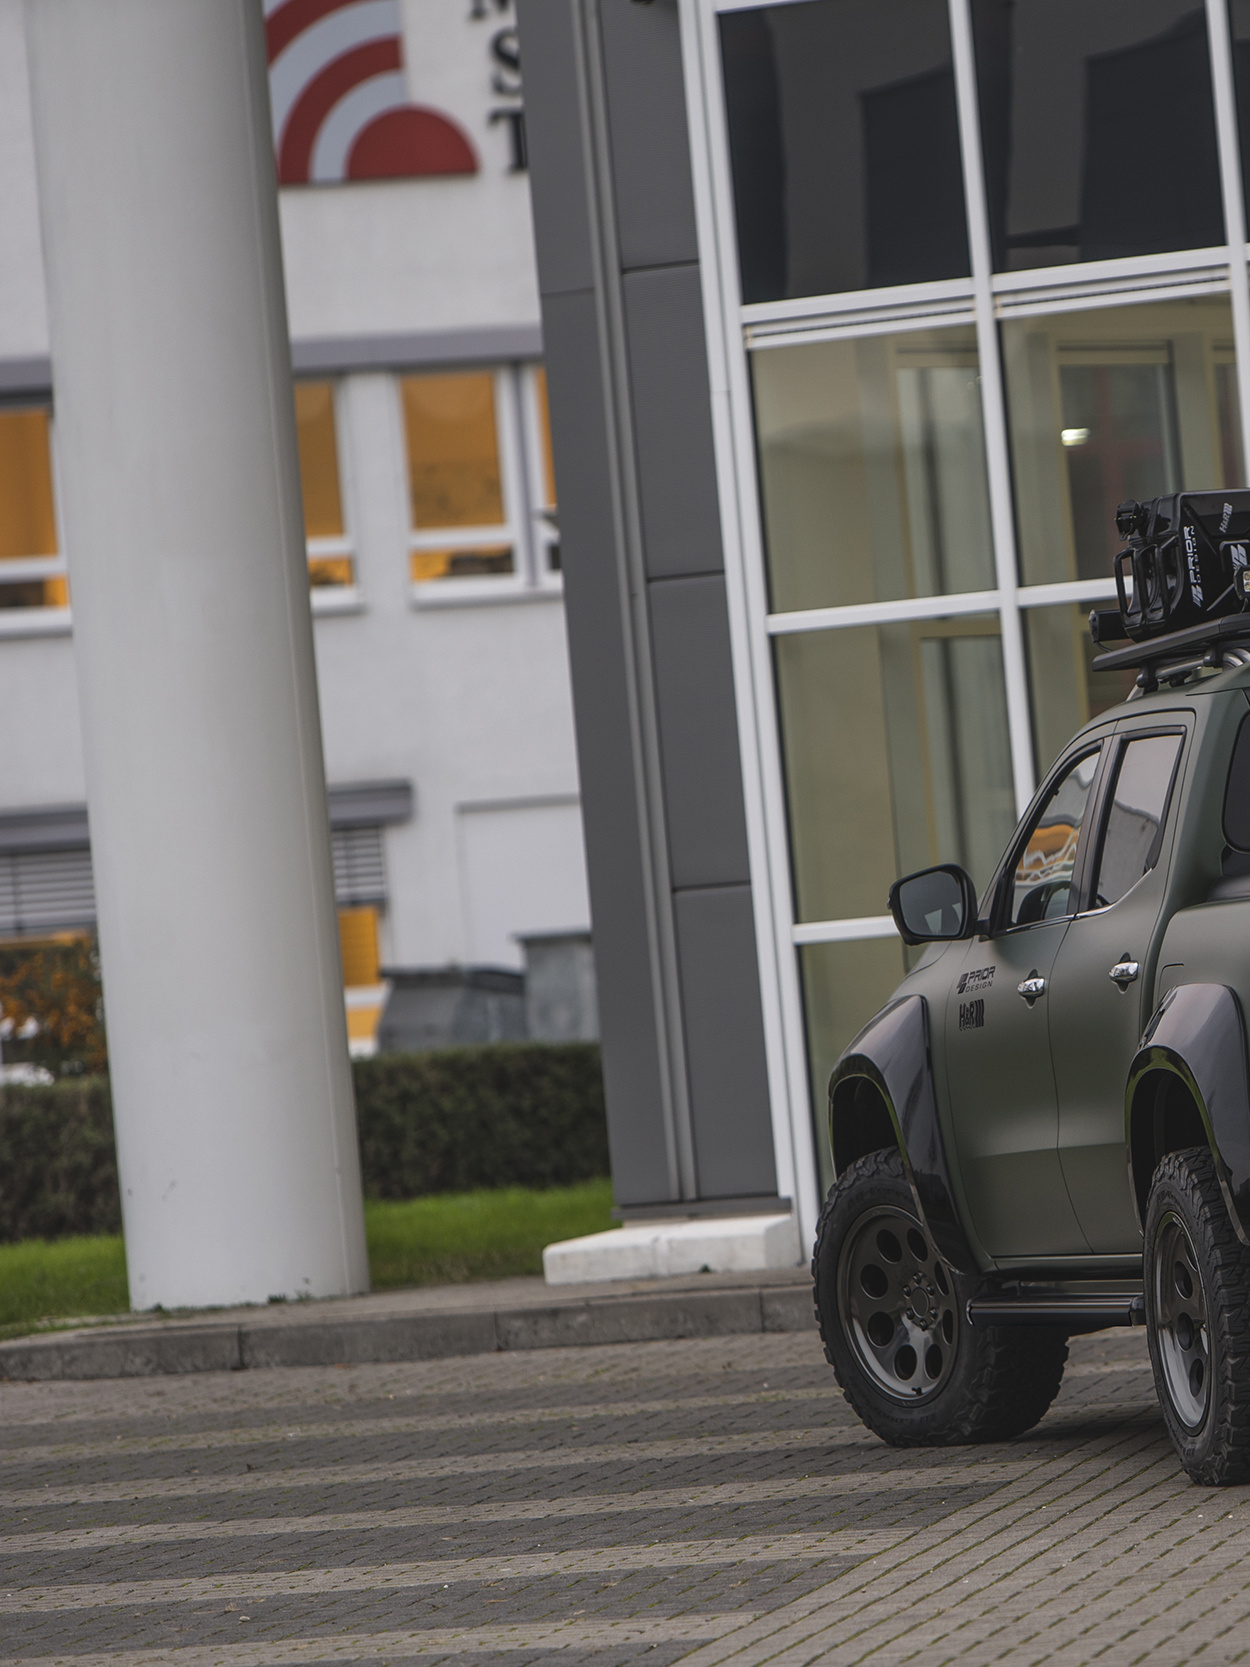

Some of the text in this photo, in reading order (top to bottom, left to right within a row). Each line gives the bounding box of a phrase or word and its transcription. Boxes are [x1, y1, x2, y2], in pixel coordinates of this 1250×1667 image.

[1183, 526, 1198, 584] PRIOR
[967, 966, 996, 984] PRIOR
[965, 980, 993, 993] DESIGN
